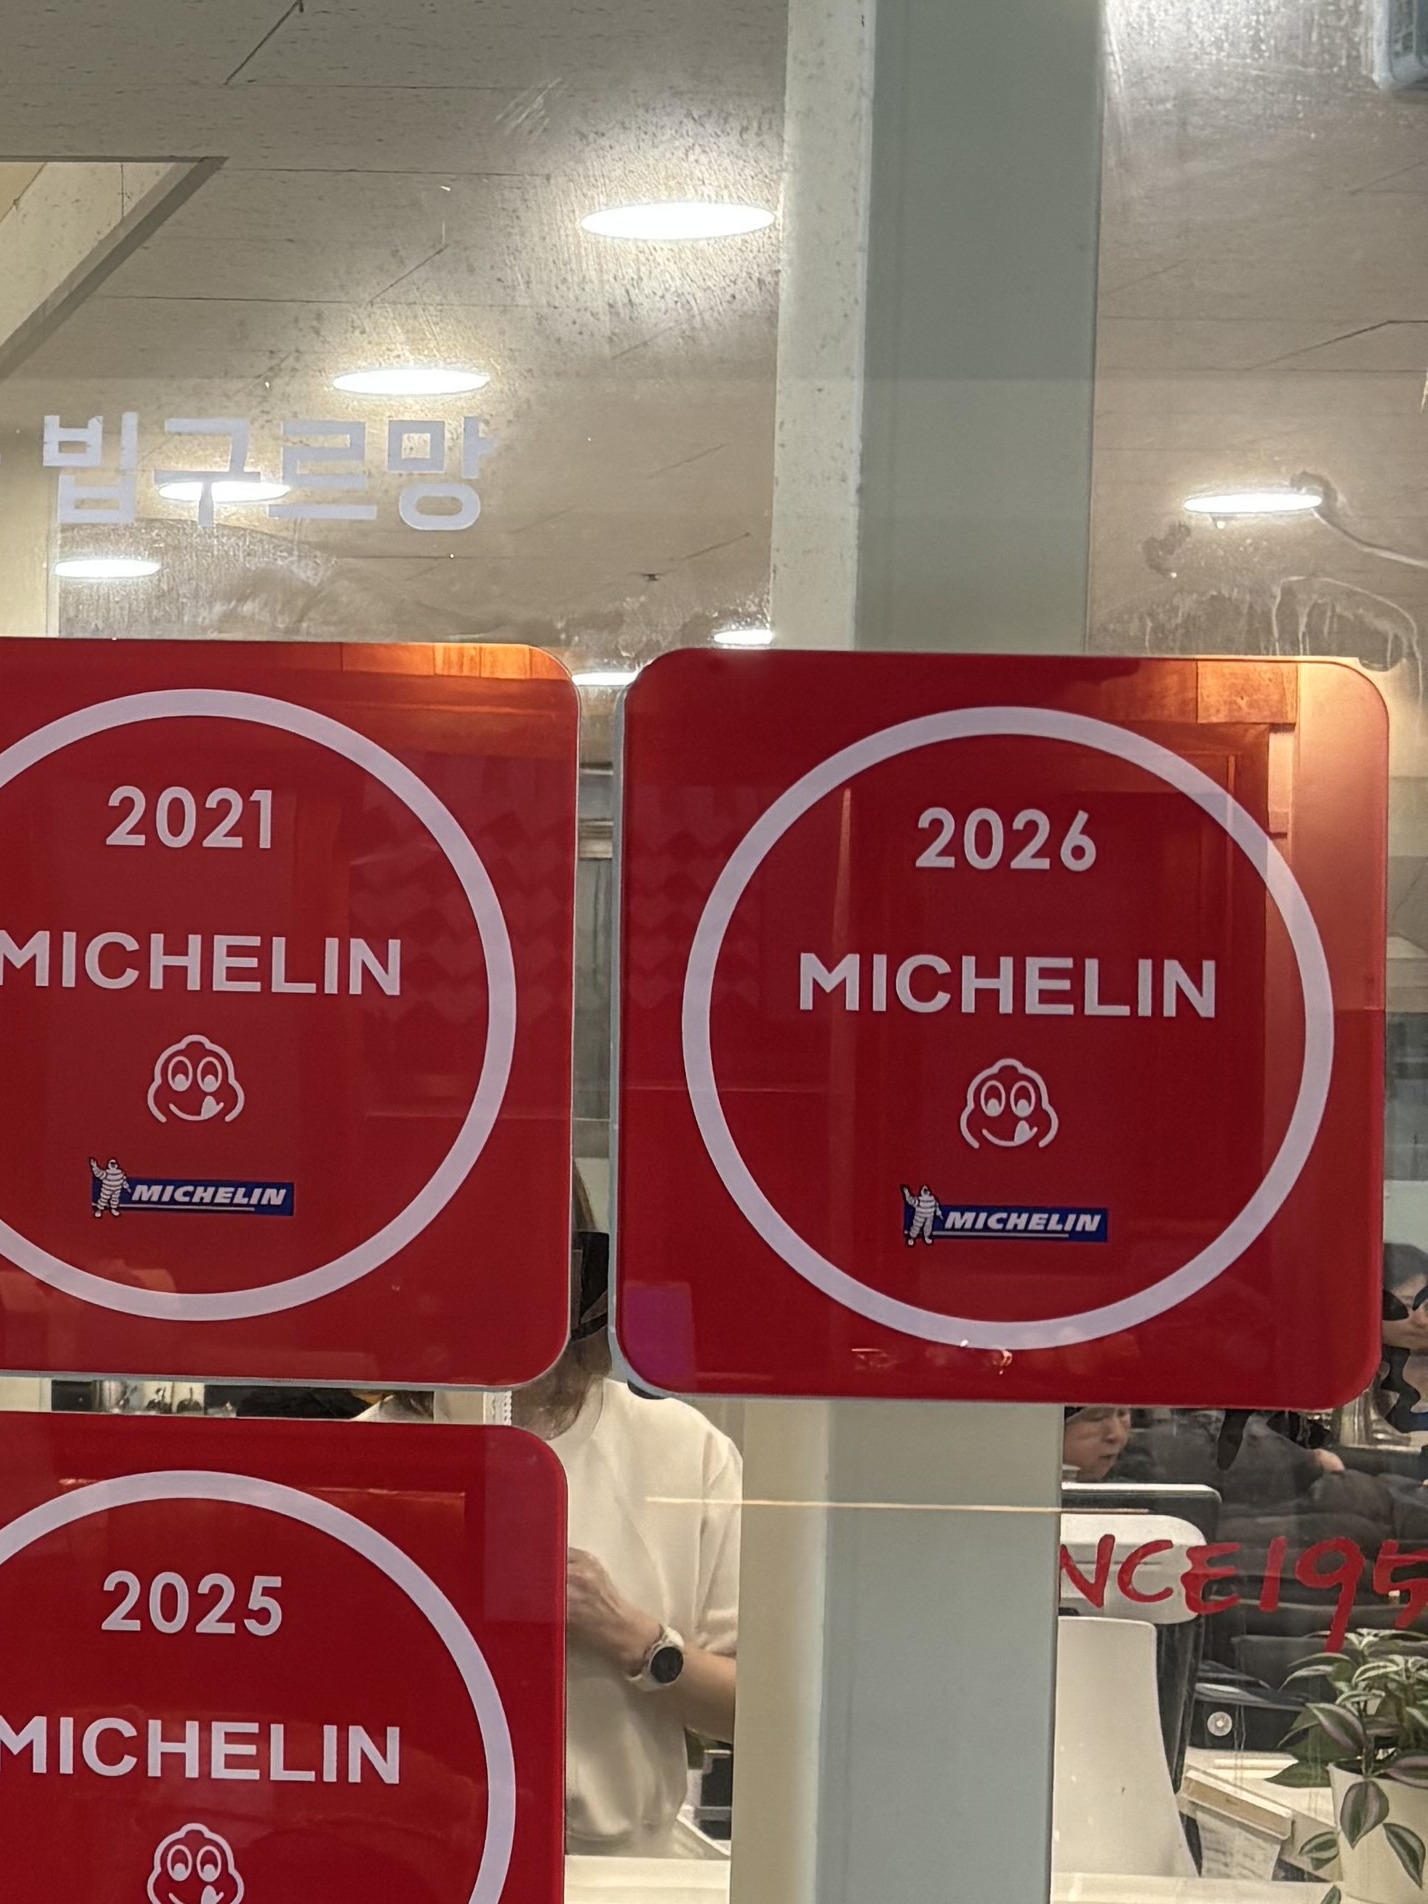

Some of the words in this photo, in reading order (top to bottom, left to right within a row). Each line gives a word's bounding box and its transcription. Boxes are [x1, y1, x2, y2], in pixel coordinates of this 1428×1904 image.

[42, 414, 495, 531] 빕구르망
[105, 785, 273, 849] 2021
[915, 807, 1096, 872] 2026
[798, 952, 1216, 1019] MICHELIN
[130, 1183, 286, 1207] MICHELIN
[944, 1210, 1100, 1233] MICHELIN
[100, 1570, 283, 1637] 2025
